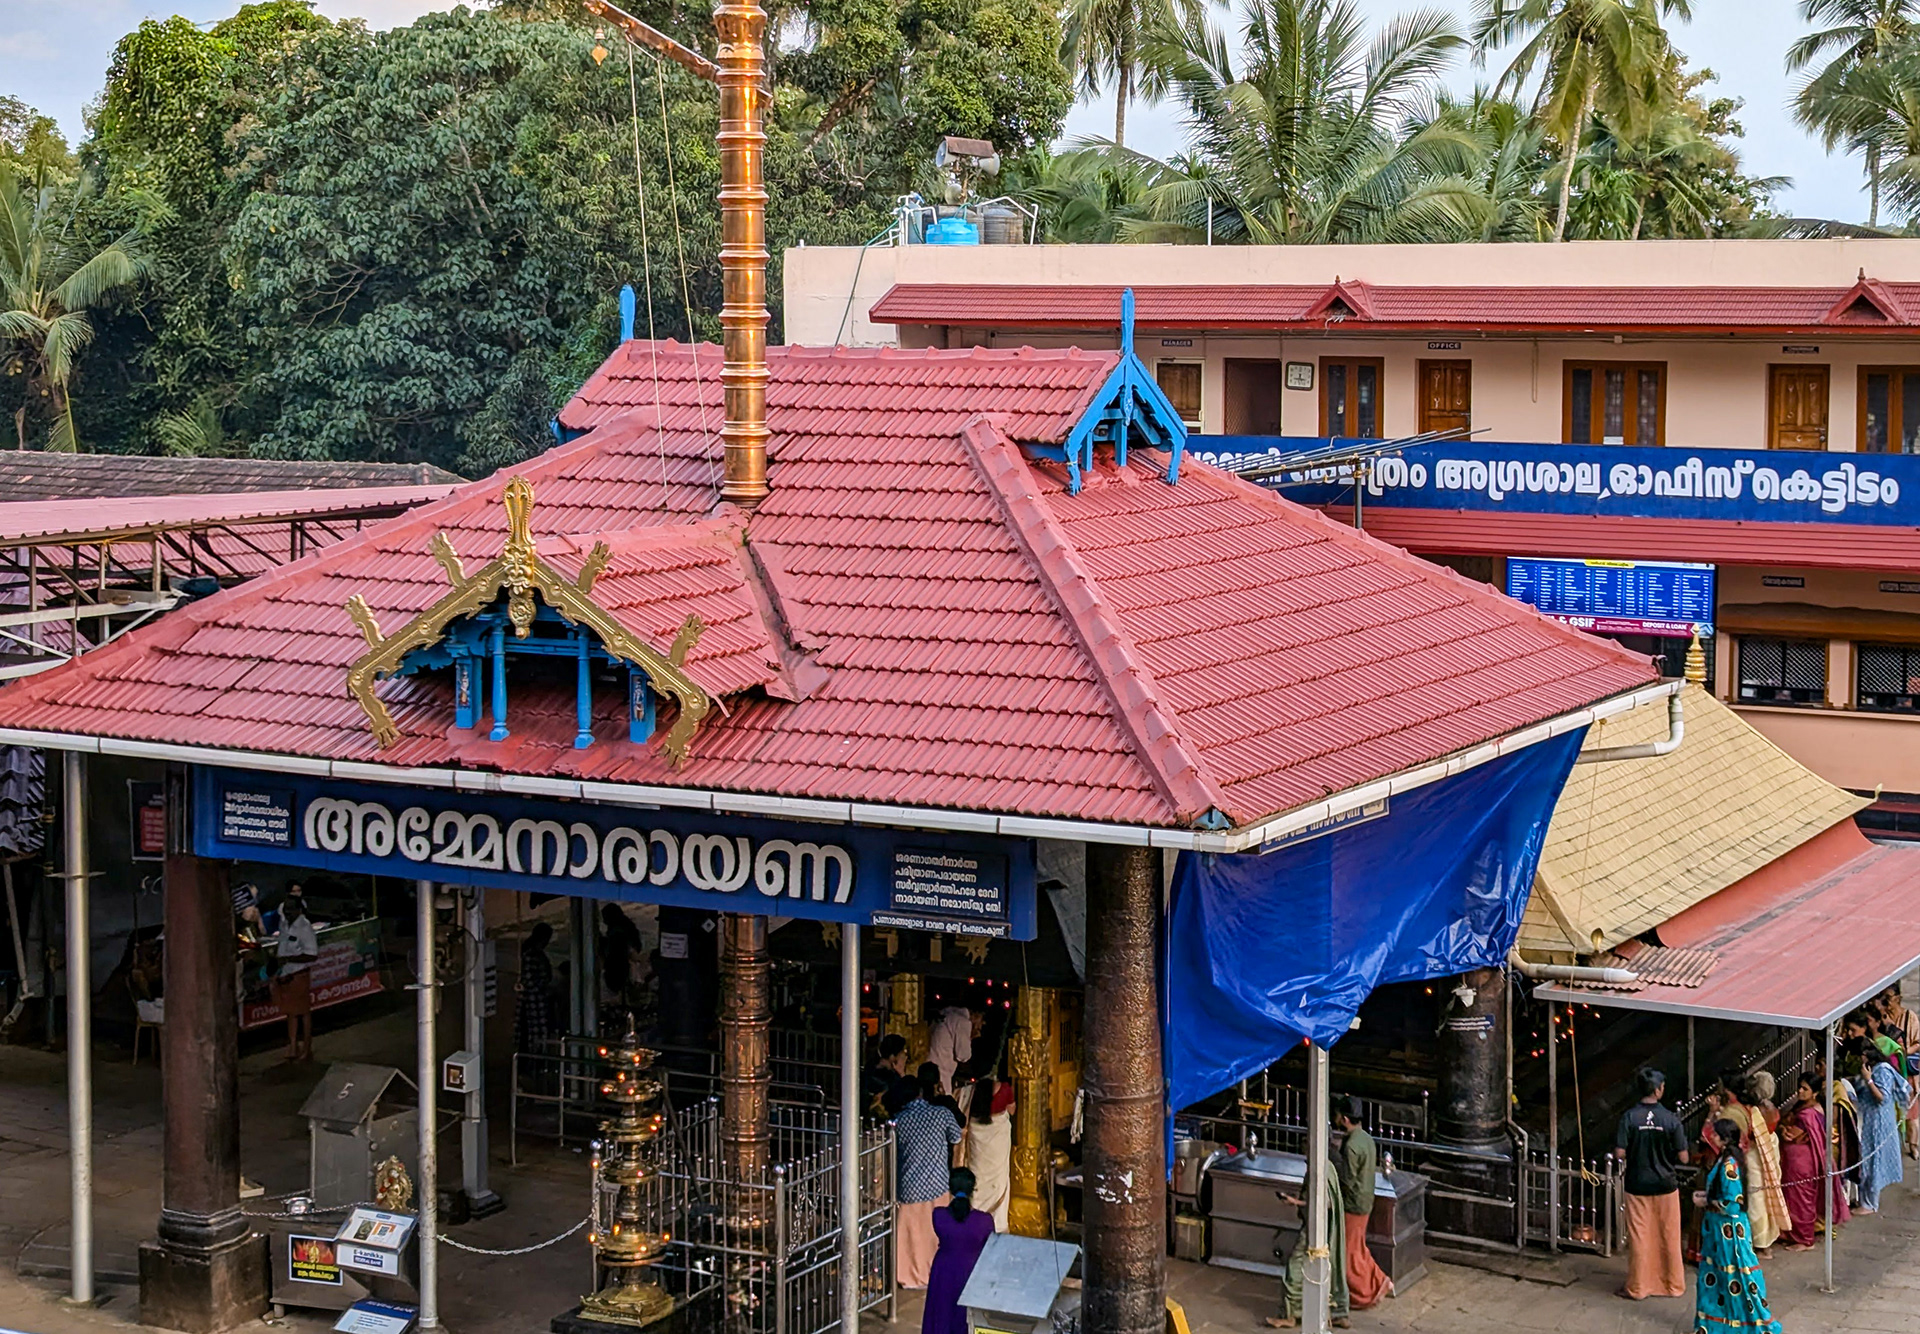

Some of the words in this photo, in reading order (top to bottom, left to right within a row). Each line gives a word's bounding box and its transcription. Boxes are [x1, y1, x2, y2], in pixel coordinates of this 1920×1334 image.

[1752, 462, 1899, 513] കെട്ടിടം
[1569, 616, 1596, 628] GSIF
[1642, 621, 1665, 629] DEPOSIT
[977, 887, 999, 899] ദേവി
[895, 893, 939, 906] നാരായണി
[939, 898, 985, 914] നമോസ്തു
